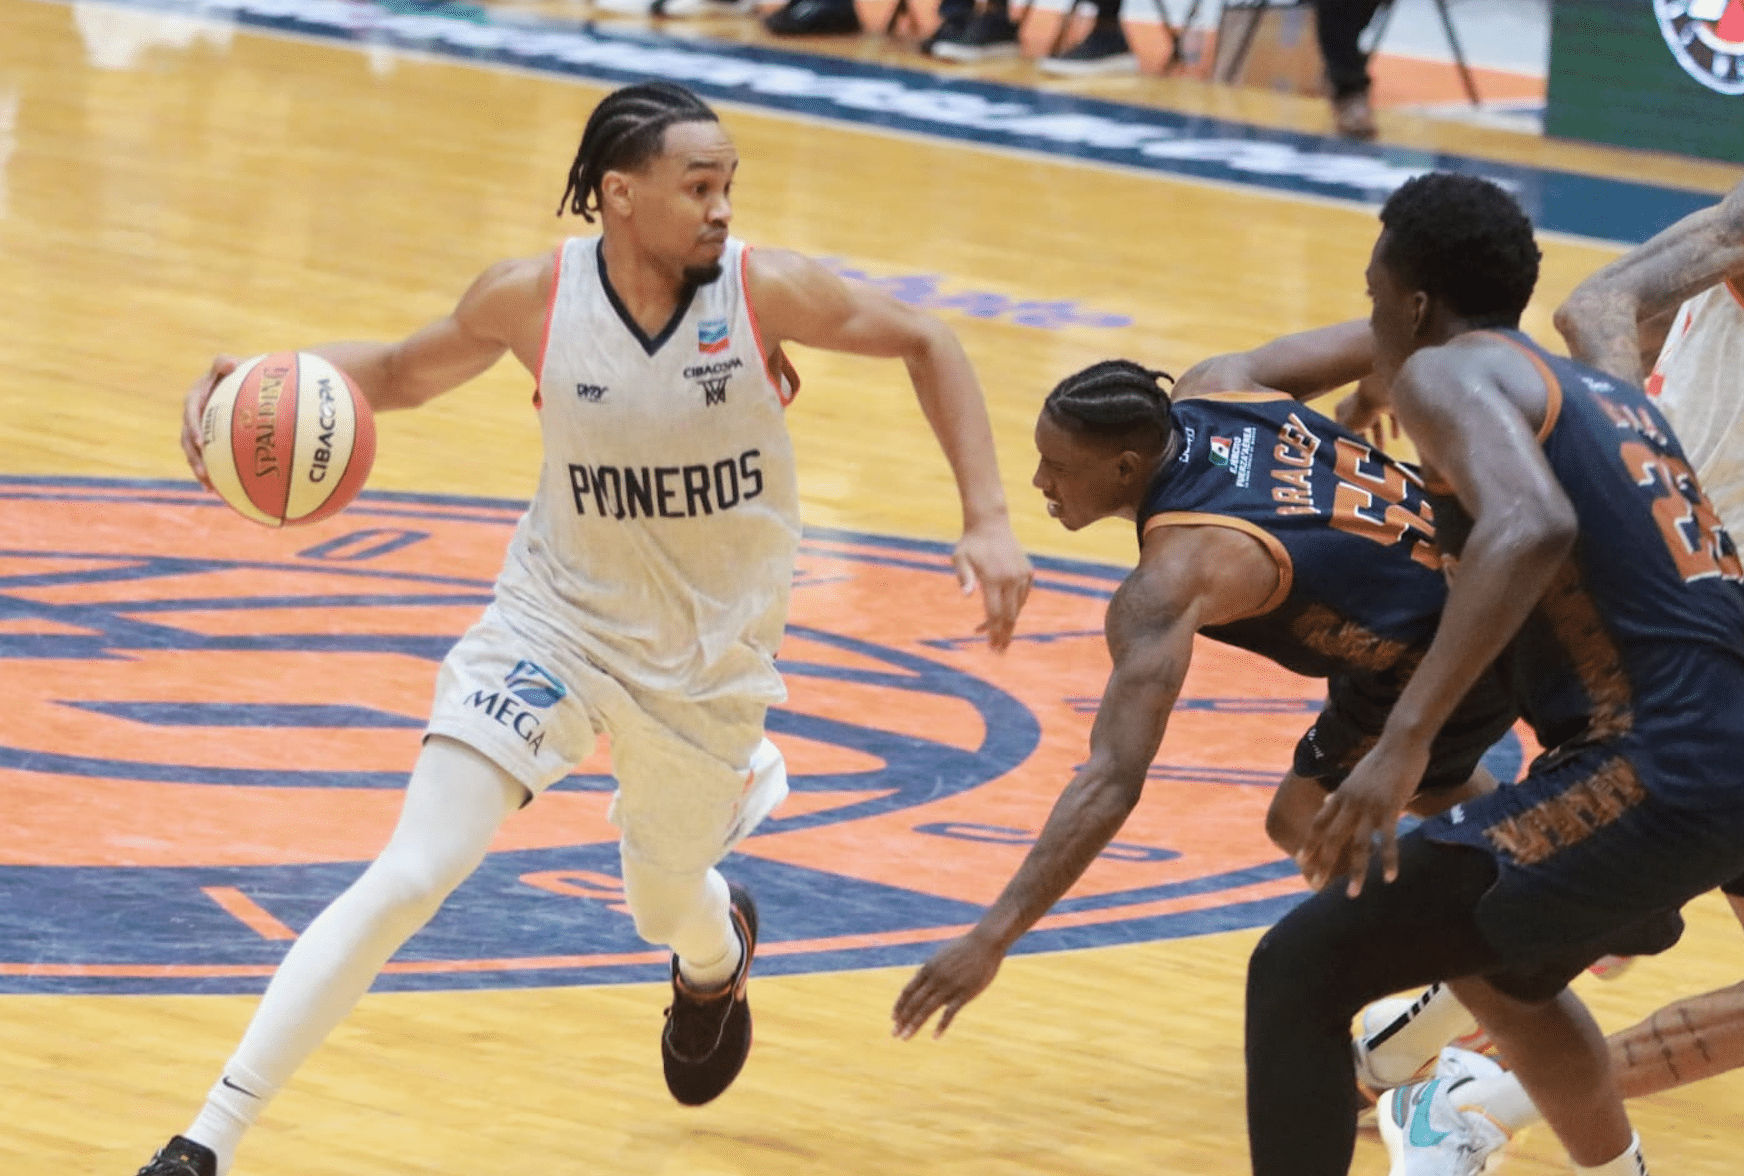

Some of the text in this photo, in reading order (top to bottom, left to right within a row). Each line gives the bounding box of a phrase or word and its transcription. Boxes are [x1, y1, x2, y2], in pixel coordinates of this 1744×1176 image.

[256, 367, 289, 478] SPALDING
[568, 448, 763, 520] PIONEROS
[463, 689, 546, 758] MEGA
